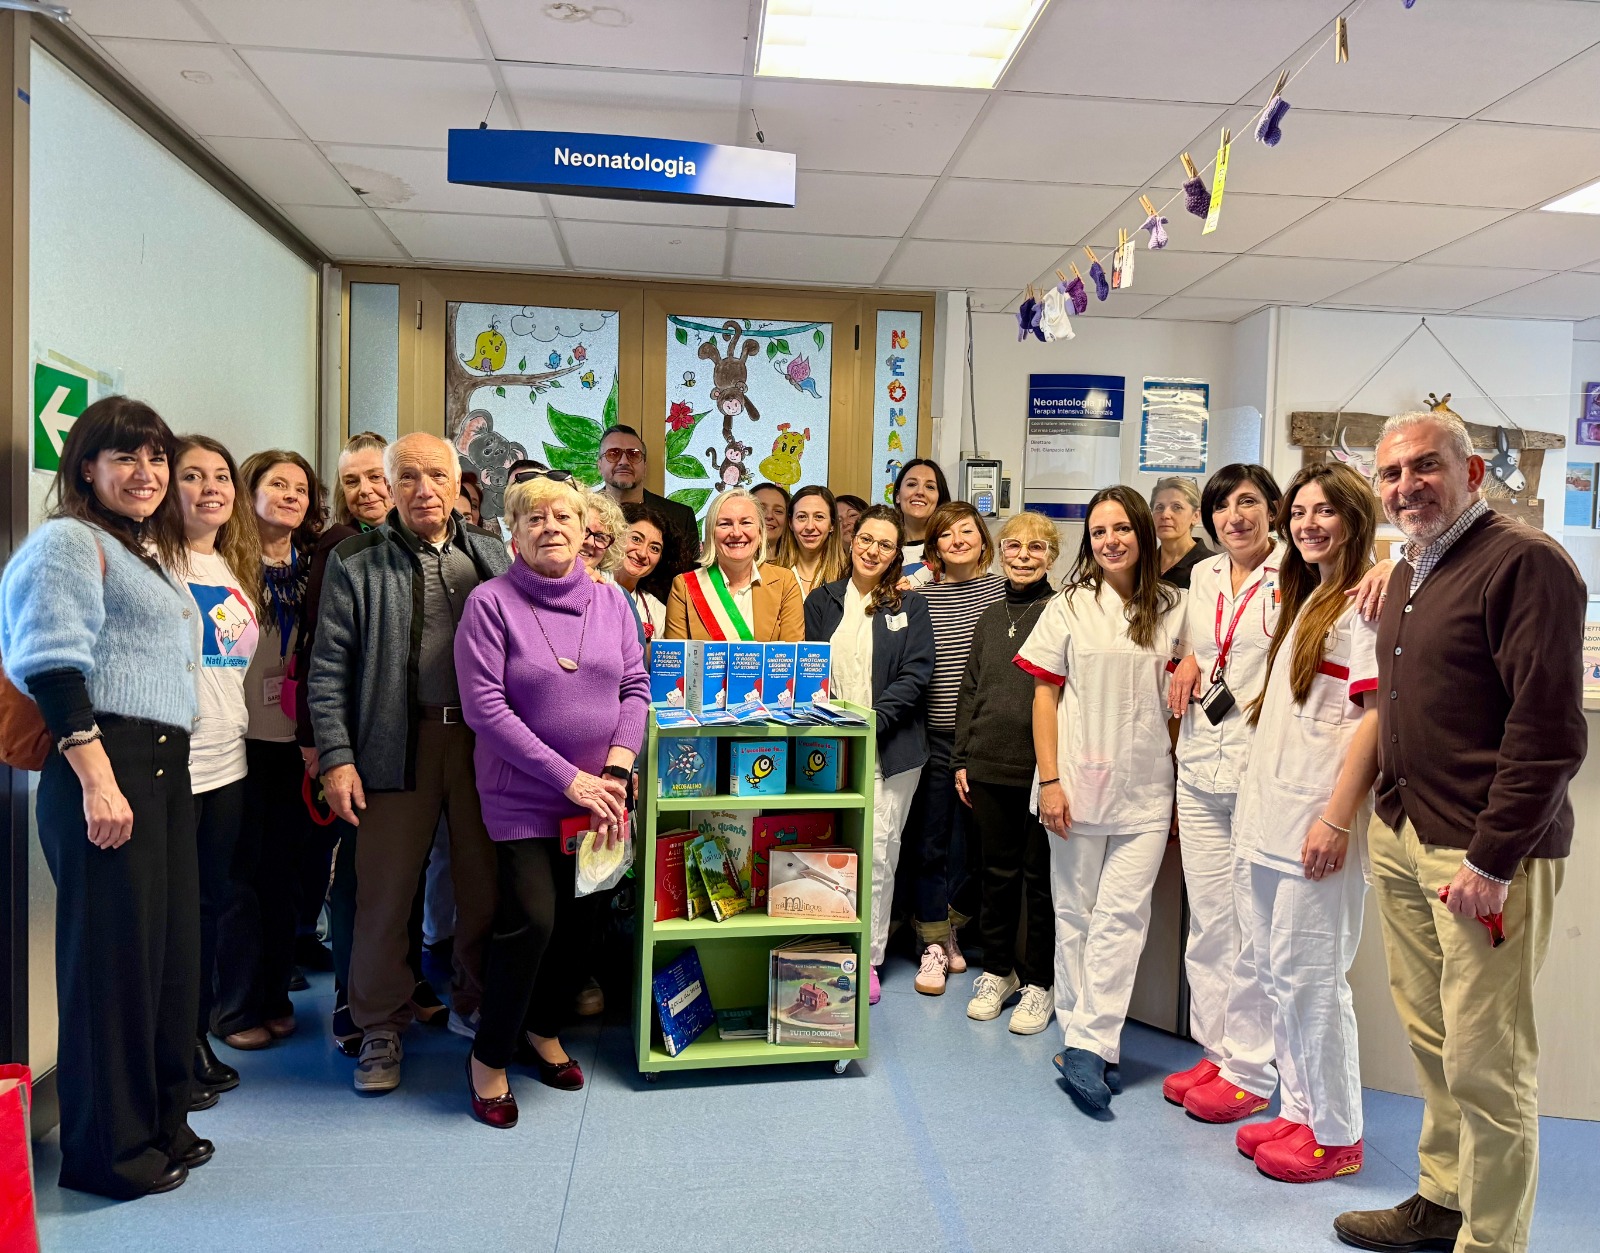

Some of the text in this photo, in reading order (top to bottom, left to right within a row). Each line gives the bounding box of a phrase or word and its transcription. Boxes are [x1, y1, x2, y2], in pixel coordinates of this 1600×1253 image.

[554, 147, 696, 178] Neonatologia
[1033, 398, 1111, 408] Neonatologia TIN
[1033, 408, 1056, 416] Terapia
[205, 656, 222, 665] Nati
[698, 819, 747, 837] oh, quante
